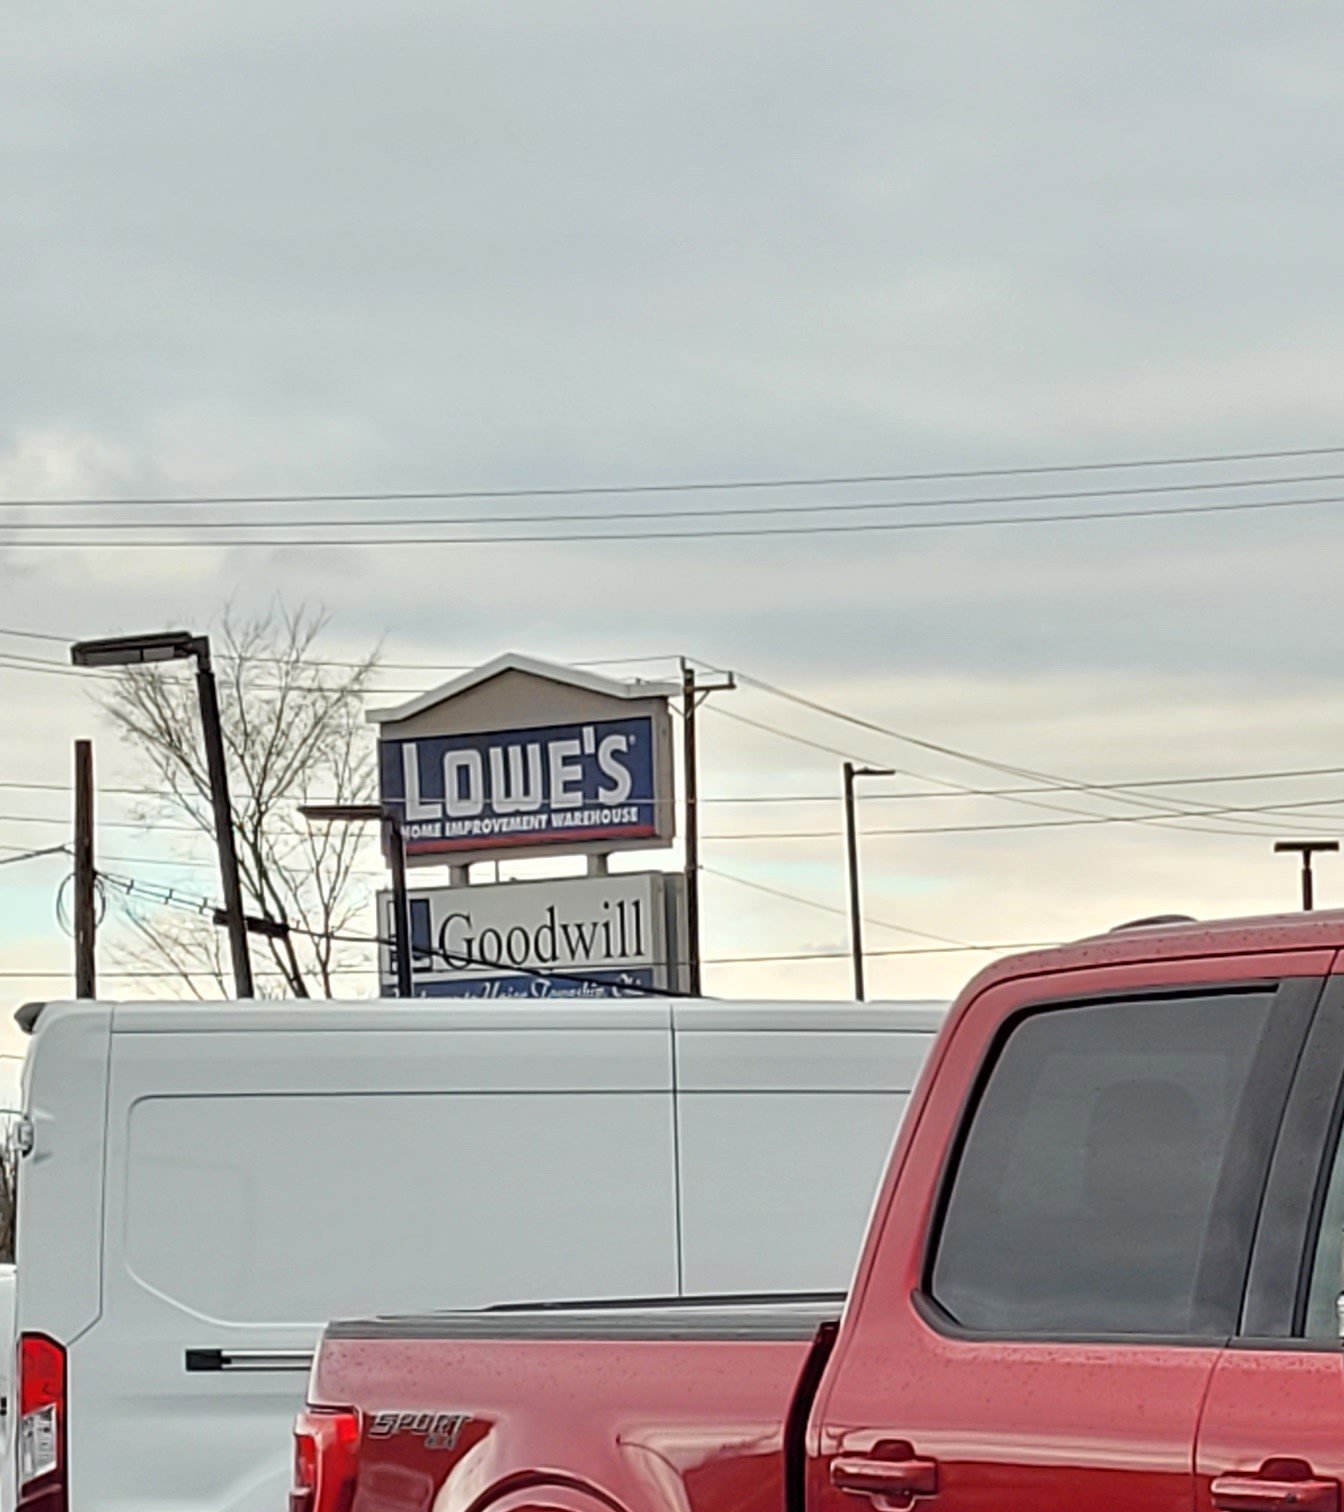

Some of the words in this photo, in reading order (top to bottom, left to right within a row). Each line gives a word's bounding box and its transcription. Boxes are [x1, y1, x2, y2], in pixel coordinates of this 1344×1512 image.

[402, 725, 634, 823] LOWE'S
[400, 822, 442, 841] HOME
[445, 814, 548, 838] IMPROVEMENT
[551, 806, 638, 828] WAREHOUSE
[438, 899, 646, 969] Goodwill
[368, 1410, 473, 1439] SPORT
